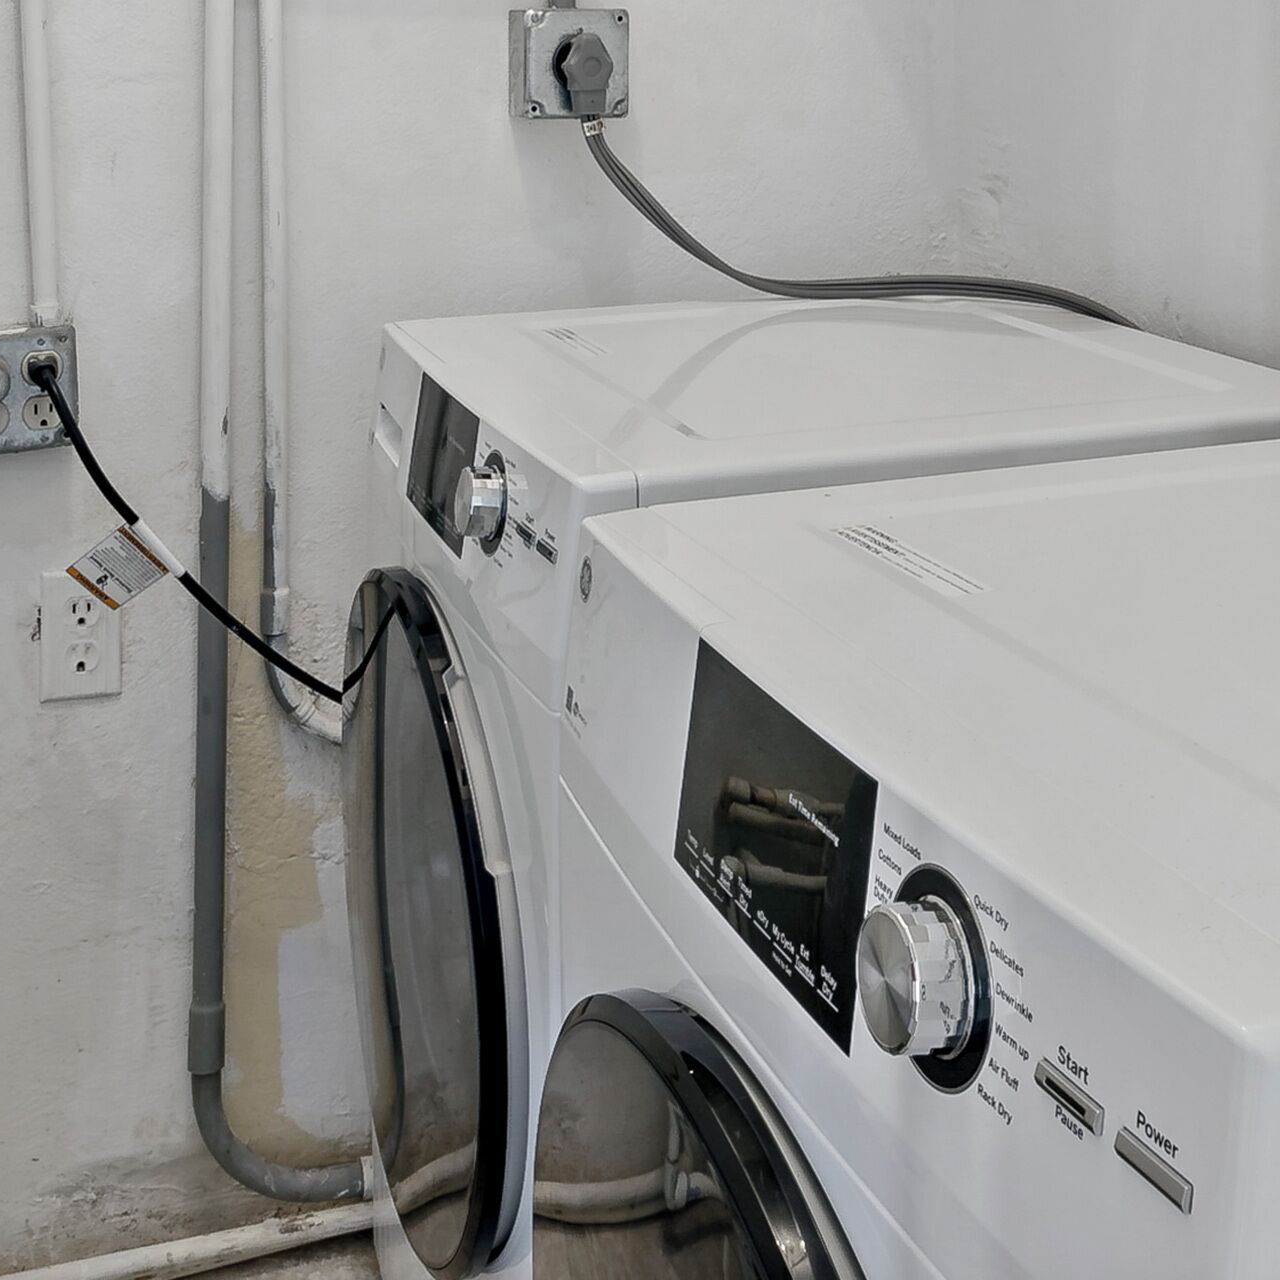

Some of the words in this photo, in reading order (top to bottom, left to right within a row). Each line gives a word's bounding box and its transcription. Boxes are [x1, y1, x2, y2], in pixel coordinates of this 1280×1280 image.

[798, 800, 811, 821] Time
[811, 813, 839, 848] Remaining
[883, 823, 902, 846] Mixed
[902, 837, 921, 861] Loads
[878, 848, 902, 876] Cottons
[875, 874, 893, 899] Heavy
[974, 894, 994, 920] Quick
[995, 910, 1009, 932] Dry
[772, 923, 781, 942] My
[780, 932, 795, 955] Cycle
[990, 940, 1024, 977] Delicates
[820, 965, 837, 991] Delay
[995, 982, 1034, 1023] Dewrinkle
[995, 1021, 1017, 1051] Warm
[1018, 1045, 1030, 1062] up
[988, 1057, 1000, 1075] Air
[1000, 1065, 1019, 1093] Fluff
[1057, 1045, 1090, 1086] Start
[977, 1083, 997, 1111] Rack
[997, 1102, 1013, 1125] Dry
[1054, 1104, 1085, 1141] Pause
[1136, 1110, 1179, 1159] Power
